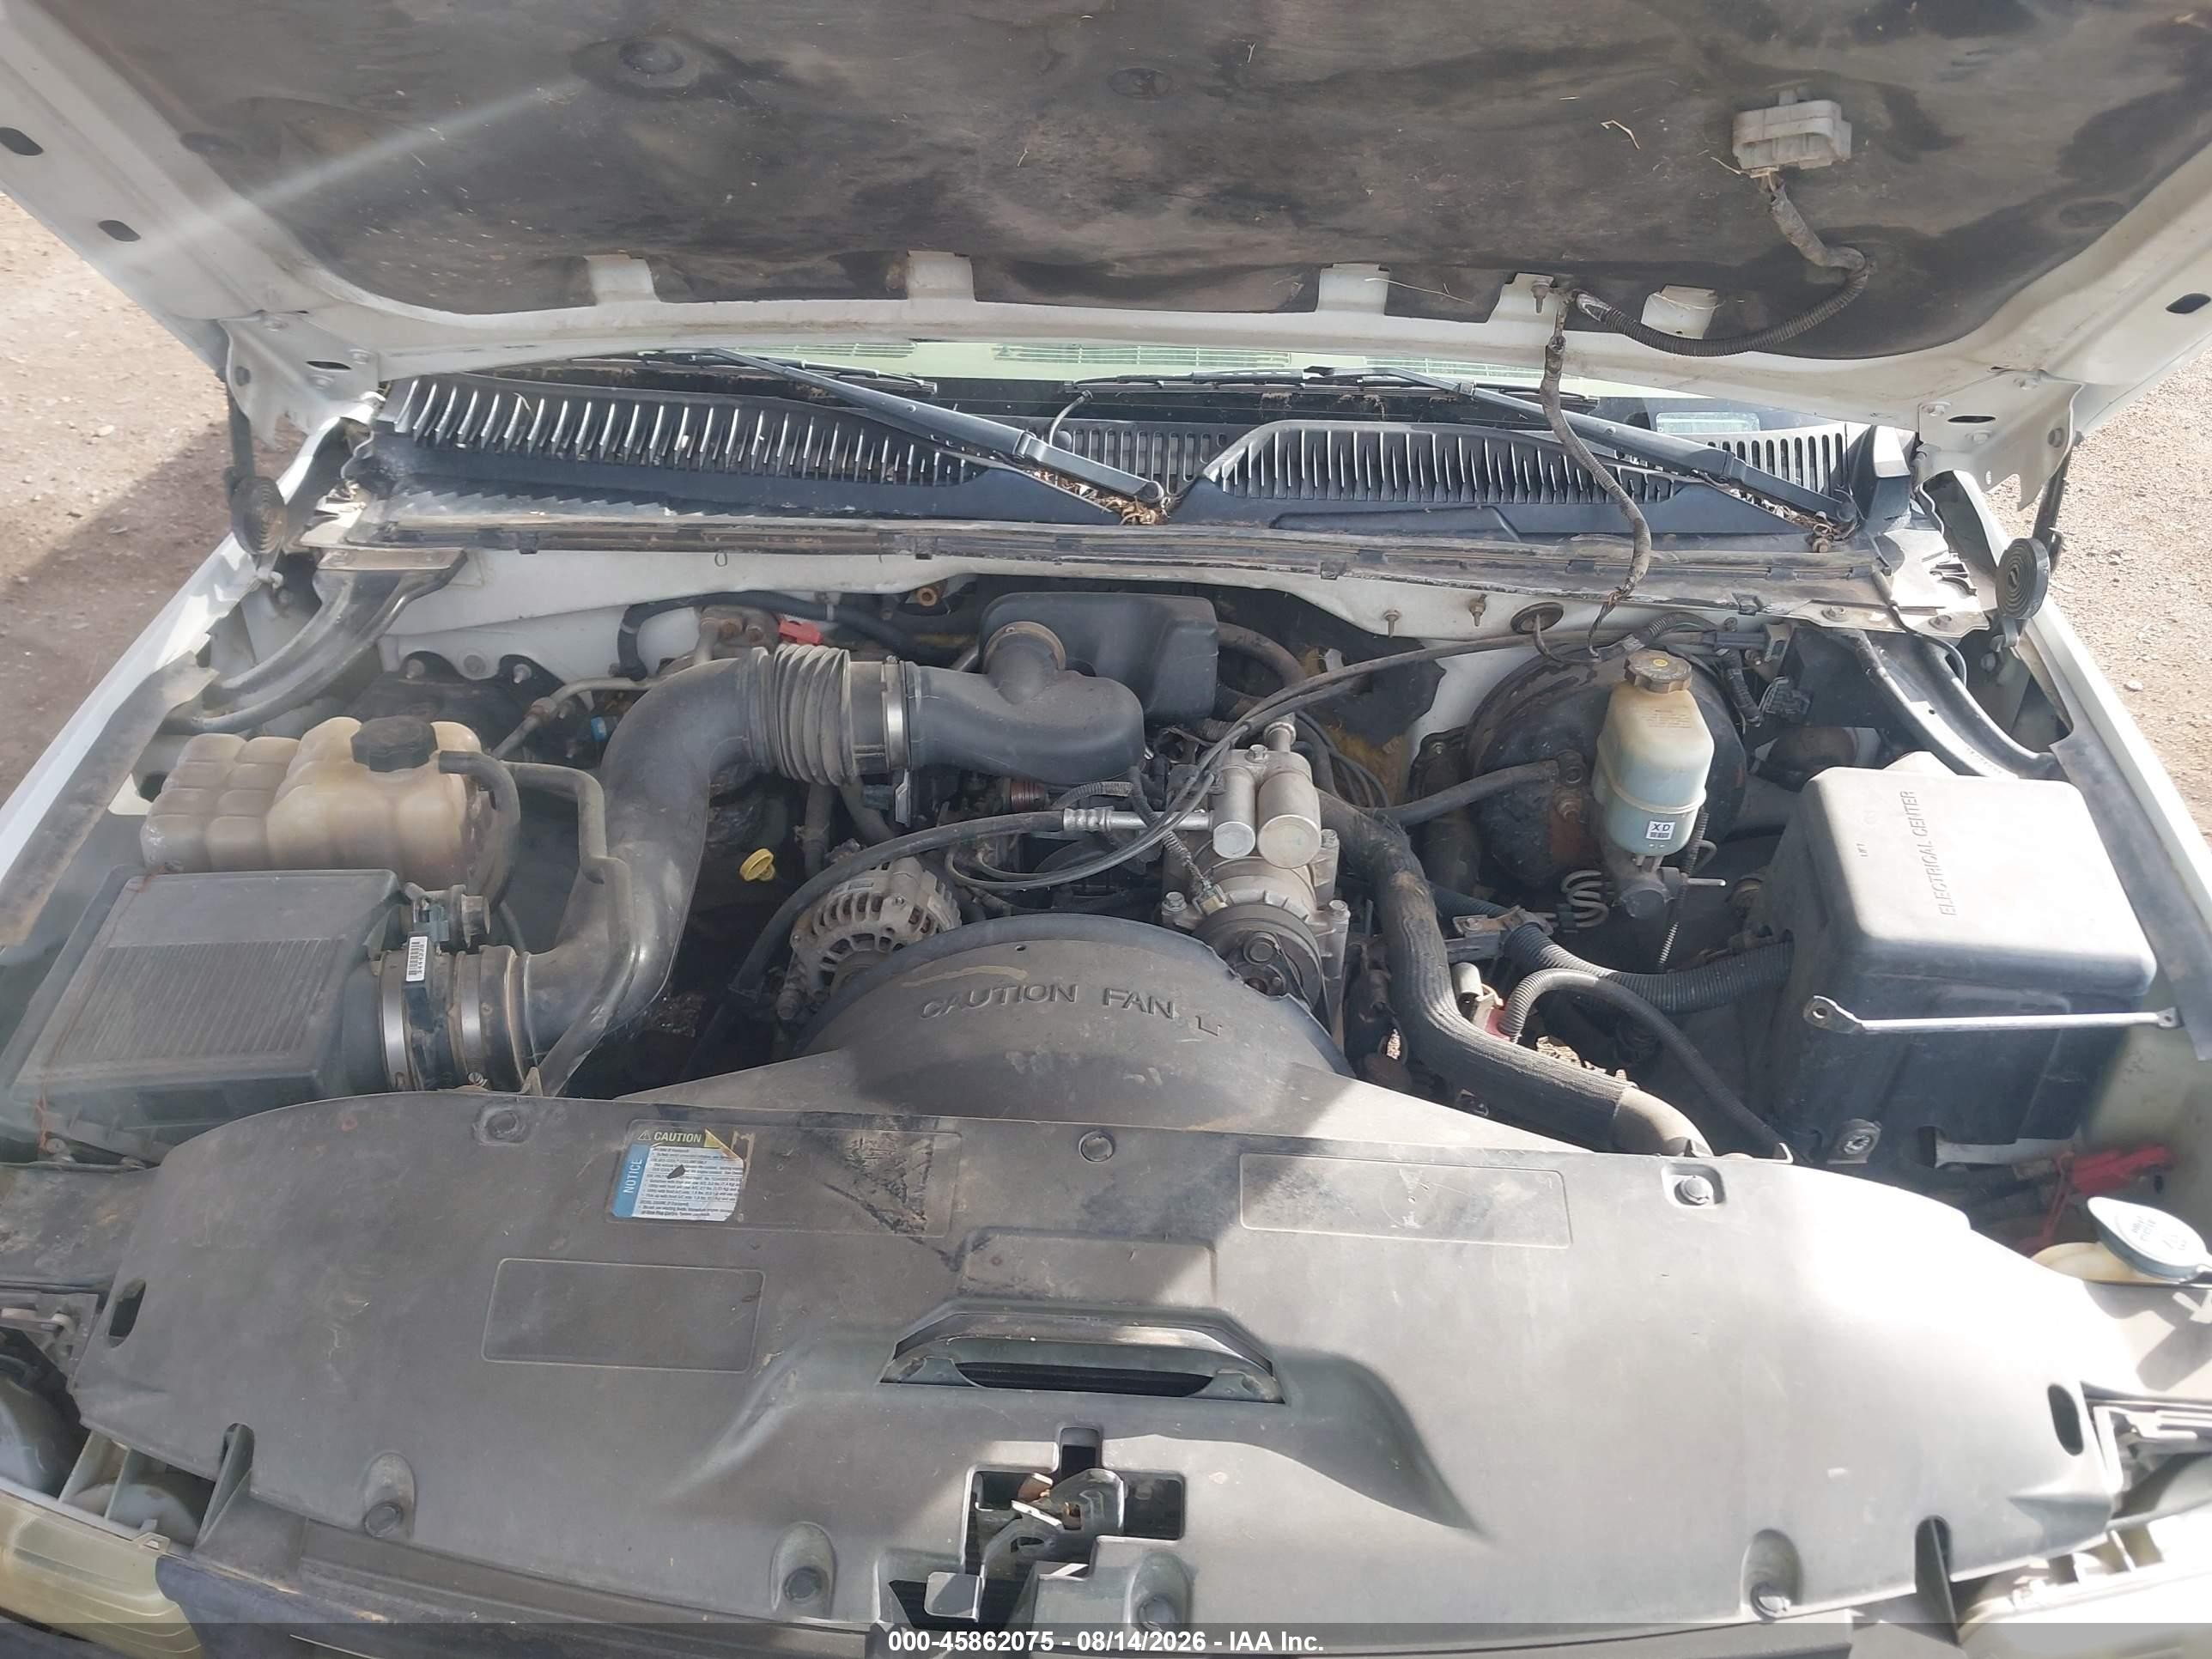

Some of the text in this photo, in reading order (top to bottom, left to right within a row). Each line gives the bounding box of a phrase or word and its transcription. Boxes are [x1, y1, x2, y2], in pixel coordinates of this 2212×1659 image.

[1899, 790, 1958, 916] ELECTRICAL CENTER
[921, 983, 1176, 1020] CAUTION FAN
[653, 1131, 702, 1144] CAUTION
[623, 1158, 643, 1194] NOTICE
